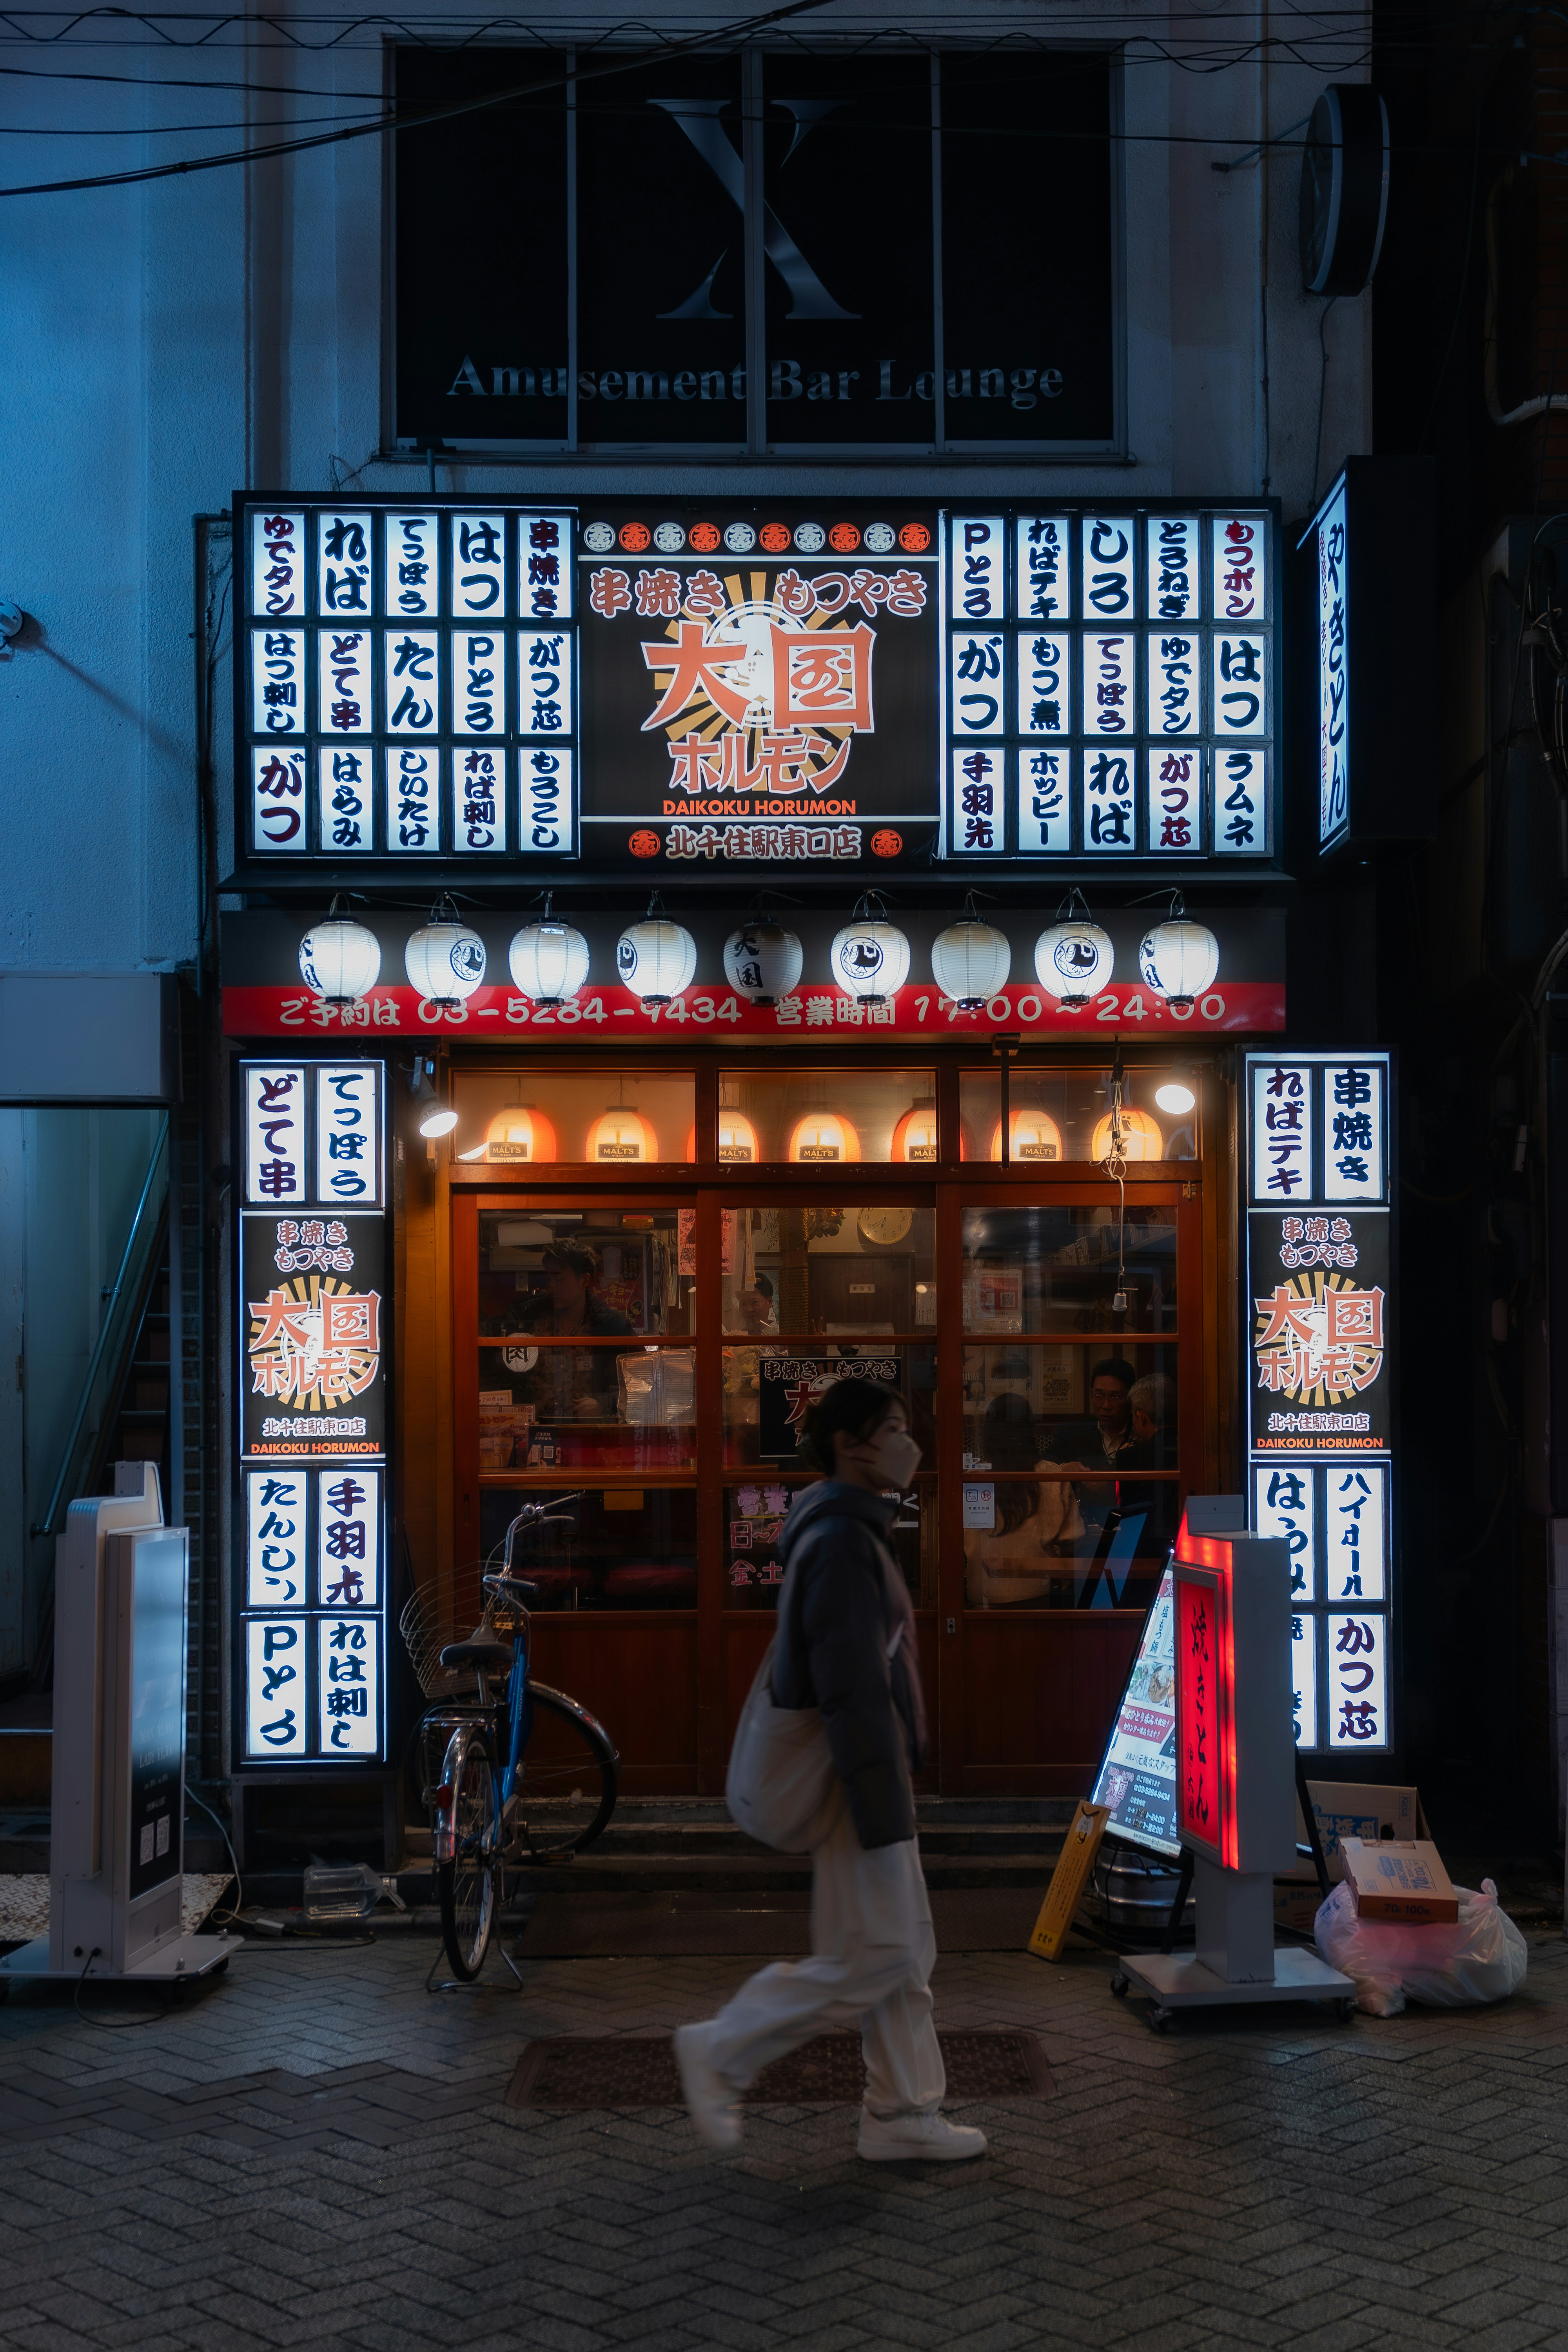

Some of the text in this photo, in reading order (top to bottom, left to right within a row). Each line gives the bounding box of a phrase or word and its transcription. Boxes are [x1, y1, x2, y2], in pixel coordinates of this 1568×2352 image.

[646, 98, 862, 319] X
[447, 354, 1063, 410] Amusement Bar Lounge
[263, 516, 296, 615] ゆでタン
[324, 517, 370, 611] れば
[398, 518, 428, 614] てっぽう
[460, 521, 501, 611] はつ
[528, 519, 560, 616] 串焼き
[590, 567, 927, 618] 串焼き もつやき
[962, 523, 992, 617] Pとろ
[1027, 520, 1061, 617] ればテキ
[1088, 520, 1129, 614] しろ
[1157, 521, 1191, 617] とろねぎ
[263, 633, 297, 731] はつ刺し
[330, 633, 363, 731] どて串
[391, 635, 435, 729] たん
[464, 636, 495, 731] Pとろ
[530, 635, 564, 731] がつ芯
[641, 619, 877, 733] 大国
[957, 636, 1003, 730] がつ
[1029, 636, 1061, 731] もつ煮
[1096, 637, 1128, 733] てっぽう
[1159, 637, 1192, 733] ゆでタン
[1220, 639, 1261, 728] はつ
[1328, 523, 1345, 828] やきとん
[257, 753, 305, 844] がつ
[332, 752, 363, 847] はらみ
[397, 750, 430, 847] しいたけ
[464, 751, 495, 848] れば刺し
[530, 751, 560, 848] もろこし
[663, 800, 856, 815] DAIKOKU HORUMON
[667, 732, 851, 794] ホルモン
[961, 751, 994, 849] 手羽先
[1029, 751, 1063, 846] ホッピー
[1089, 752, 1133, 845] れば
[1159, 753, 1194, 848] がつ芯
[1223, 752, 1255, 848] ラムネ
[666, 824, 862, 859] 北千住駅東口店
[279, 996, 401, 1027] ご予約は
[775, 995, 895, 1025] 営業時間
[258, 1074, 298, 1198] どて串
[328, 1074, 368, 1196] てっぽう
[719, 1149, 748, 1158] MALT'S
[1266, 1068, 1305, 1195] ればテキ
[1333, 1069, 1372, 1182] 串焼き
[274, 1247, 354, 1272] もつやき
[277, 1220, 348, 1246] 串焼き
[1280, 1243, 1358, 1268] もつやき
[1282, 1217, 1352, 1242] 串焼き
[249, 1289, 381, 1352] 大国
[1254, 1285, 1385, 1348] 大国
[251, 1354, 379, 1397] ホルモン
[764, 1360, 897, 1381] 串焼き もつやき
[1256, 1349, 1383, 1391] ホルモン
[251, 1442, 379, 1454] DAIKOKU HORUMON
[262, 1417, 366, 1436] 北千住駅東口店
[1257, 1437, 1383, 1448] DAIKOKU HORUMON
[1268, 1412, 1370, 1432] 北千住駅東口店
[737, 1485, 792, 1516] 営業
